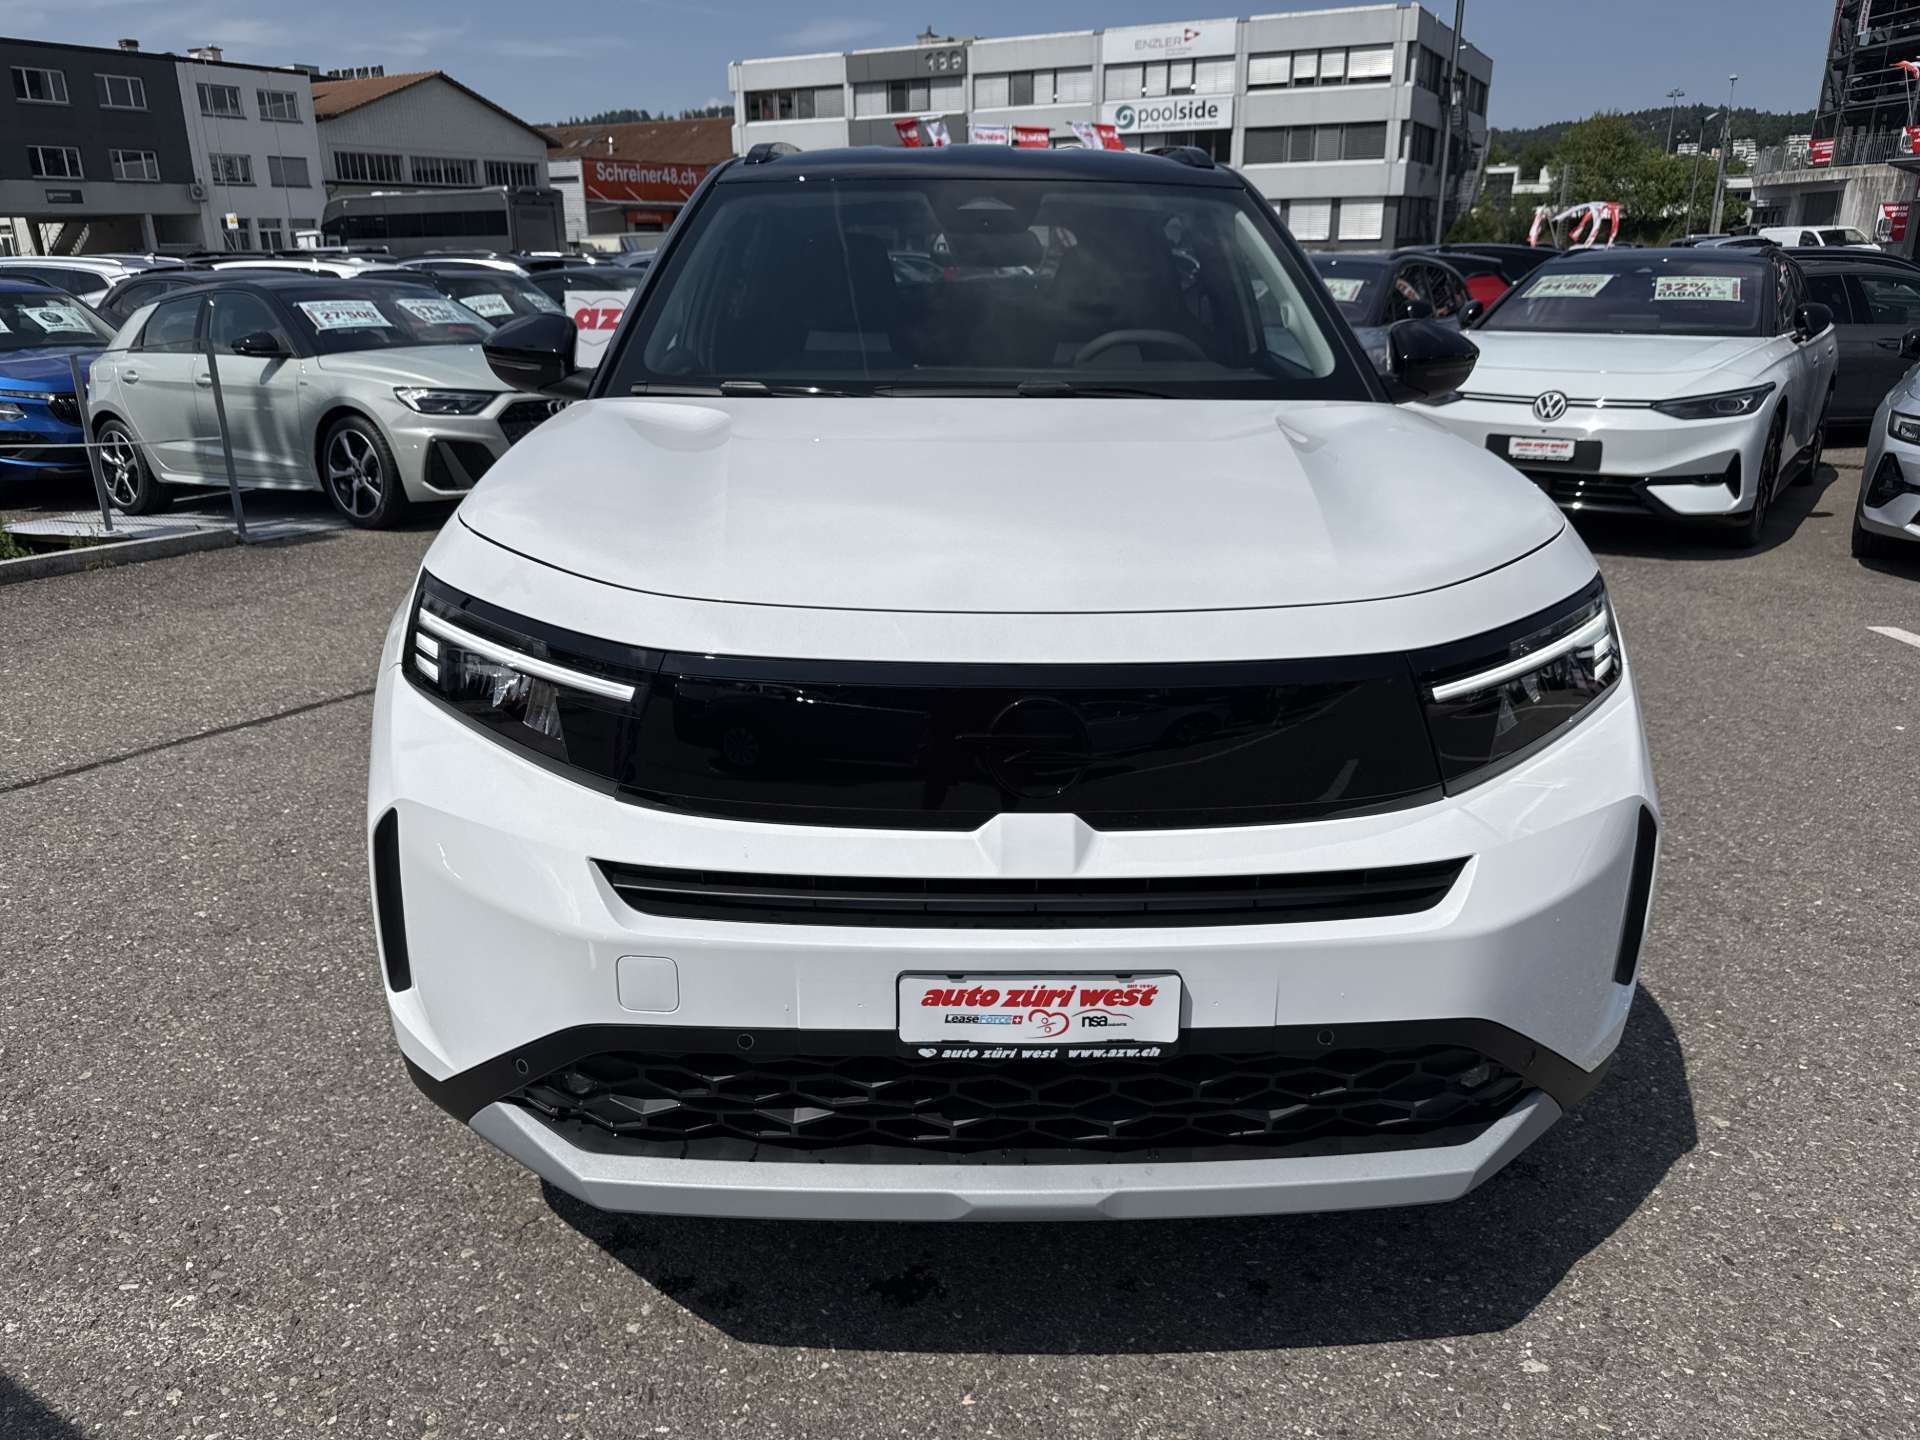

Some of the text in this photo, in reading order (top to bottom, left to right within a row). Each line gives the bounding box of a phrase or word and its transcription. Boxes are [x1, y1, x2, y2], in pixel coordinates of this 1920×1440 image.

[1134, 36, 1182, 50] ENZLER
[1138, 100, 1219, 130] poolside
[596, 161, 698, 185] Schreiner48.ch
[1658, 282, 1712, 292] 32%
[921, 985, 1159, 1007] auto züri west
[1081, 1015, 1108, 1027] nsa
[941, 1046, 1161, 1058] auto züri west www.azw.ch
